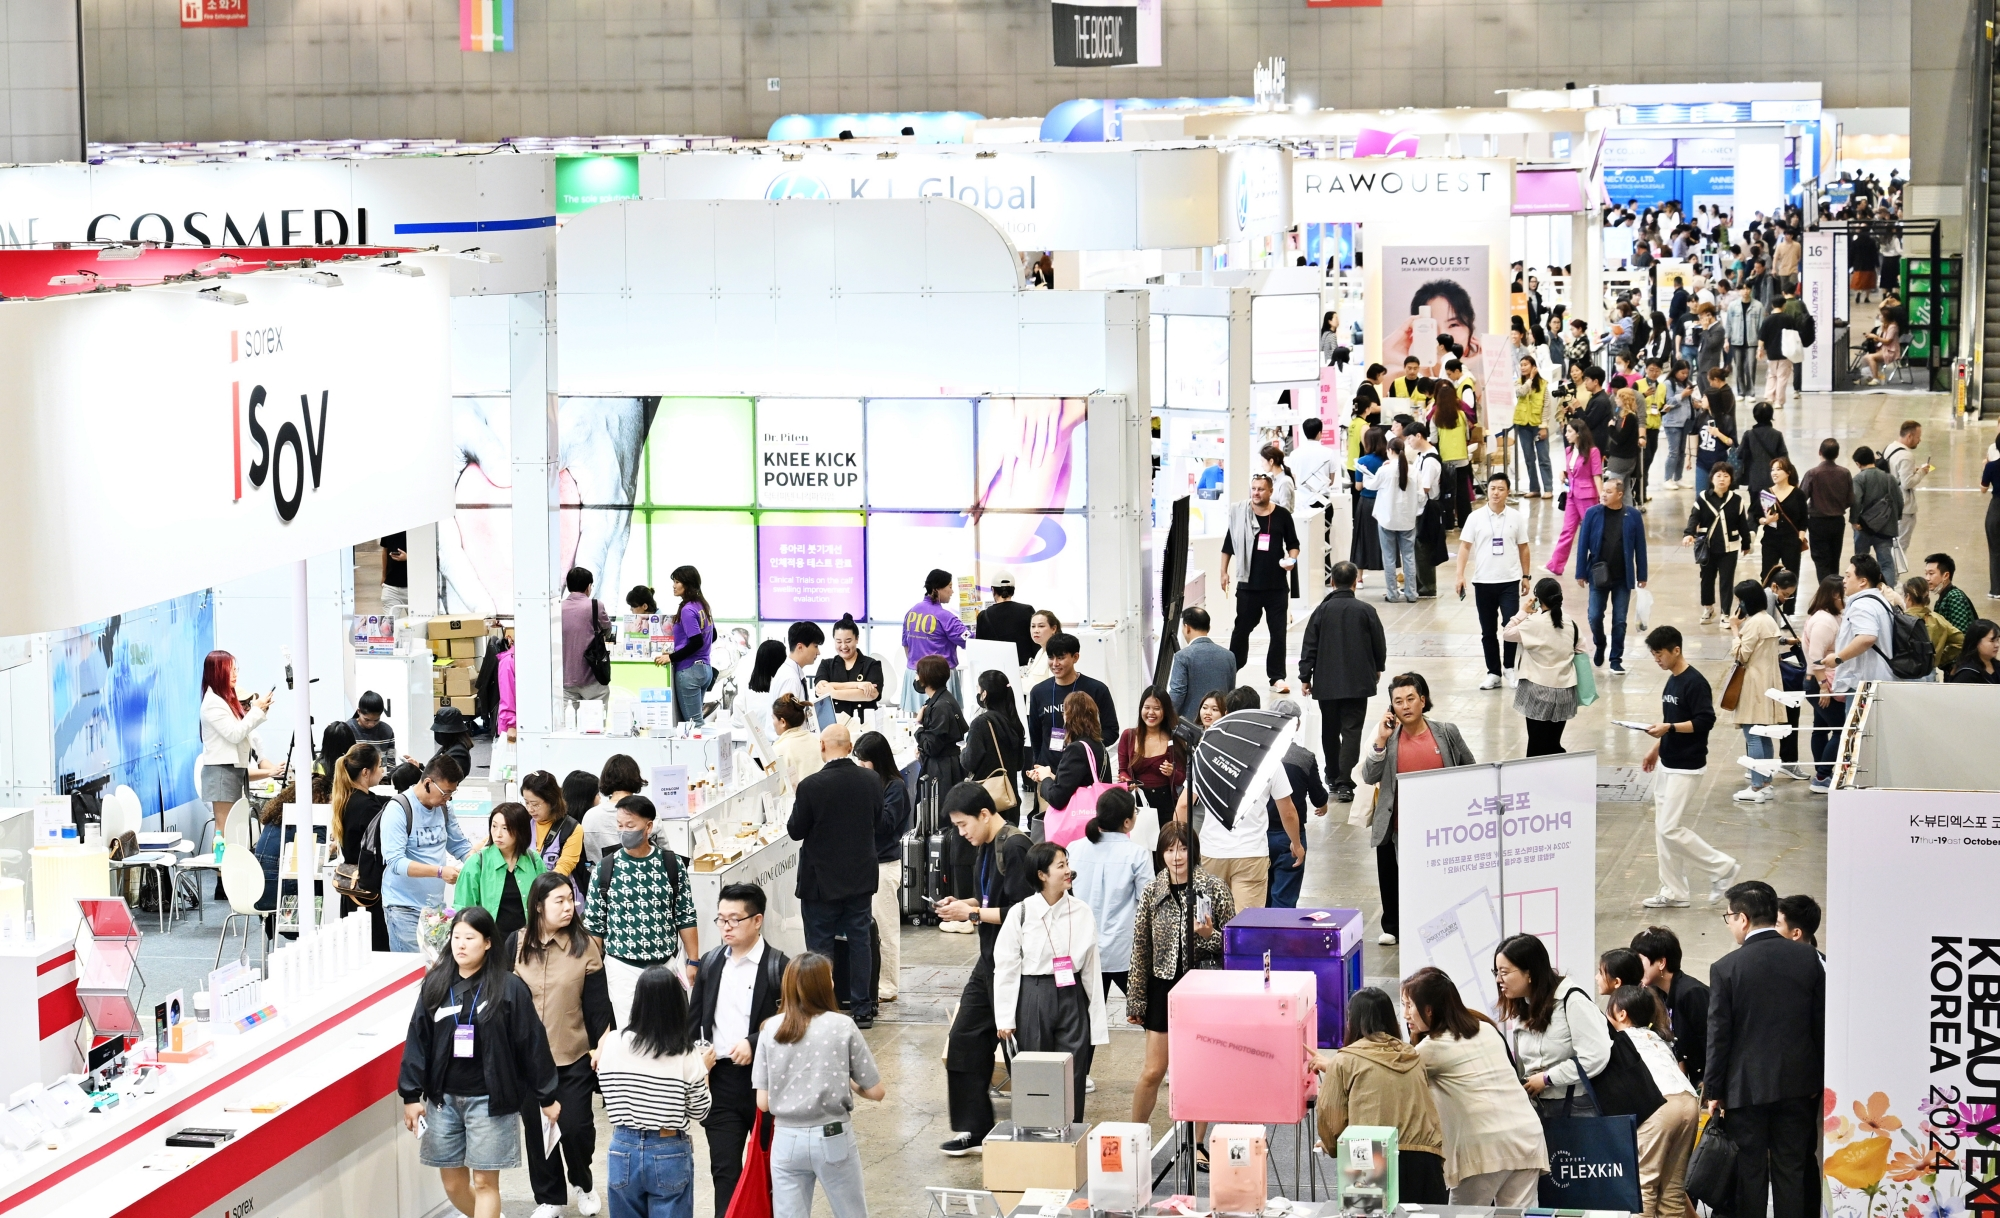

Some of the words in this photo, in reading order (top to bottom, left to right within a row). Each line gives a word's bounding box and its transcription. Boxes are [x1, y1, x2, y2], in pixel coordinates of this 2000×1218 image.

[207, 0, 240, 10] 소화기
[1074, 15, 1090, 59] THE
[1091, 15, 1123, 59] BIOGENIC
[564, 194, 579, 204] The
[581, 195, 598, 203] sole
[918, 176, 1036, 209] Global
[87, 208, 366, 249] COSMEDI
[245, 326, 283, 358] sorex
[764, 433, 778, 442] Dr.
[764, 452, 810, 466] KNEE
[815, 452, 857, 467] KICK
[764, 472, 828, 487] POWER
[834, 472, 858, 487] UP
[779, 544, 805, 554] 종아리
[807, 544, 842, 554] 붓기개선
[770, 558, 804, 568] 인체적용
[807, 558, 833, 568] 테스트
[835, 558, 853, 568] 완료
[769, 576, 794, 584] Clinical
[773, 586, 801, 594] swelling
[803, 586, 850, 594] improvement
[1212, 756, 1240, 779] NANLITE
[1910, 815, 1987, 828] K-뷰티엑스포
[1930, 936, 1963, 1074] KOREA
[1196, 1034, 1227, 1047] PICKYPIC
[1228, 1042, 1274, 1059] PHOTOBOOTH
[1929, 1084, 1961, 1174] 2024
[1560, 1162, 1623, 1180] FLEXKiN
[232, 1196, 253, 1218] sorex
